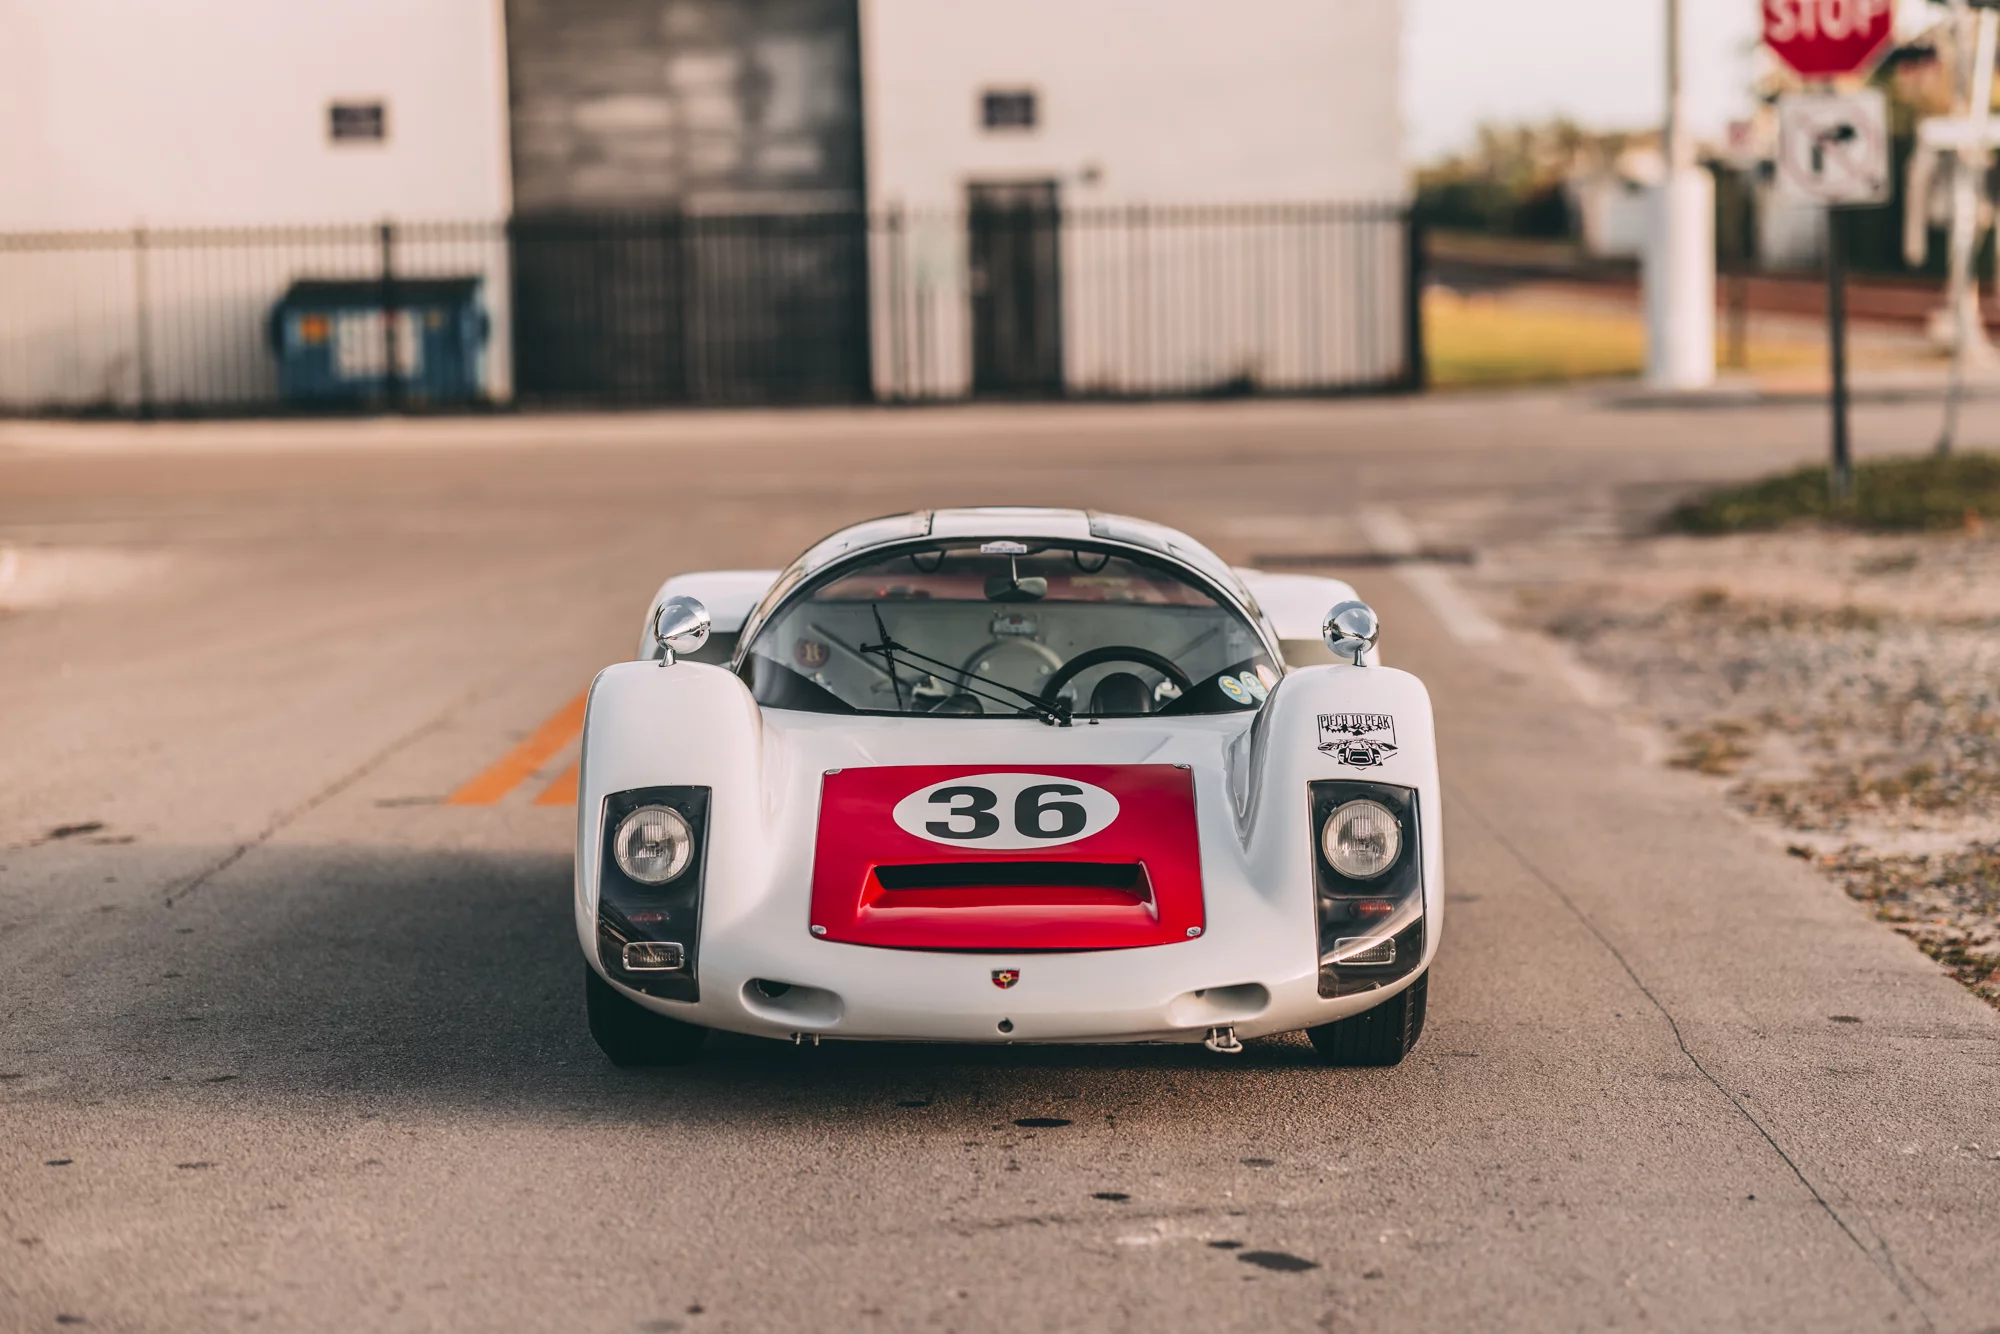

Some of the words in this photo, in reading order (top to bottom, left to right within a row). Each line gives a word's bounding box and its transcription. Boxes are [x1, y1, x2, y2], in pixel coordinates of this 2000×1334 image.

[1766, 0, 1888, 42] STOP
[1350, 714, 1362, 726] TO
[1365, 715, 1390, 729] PEAK
[925, 783, 1087, 839] 36
